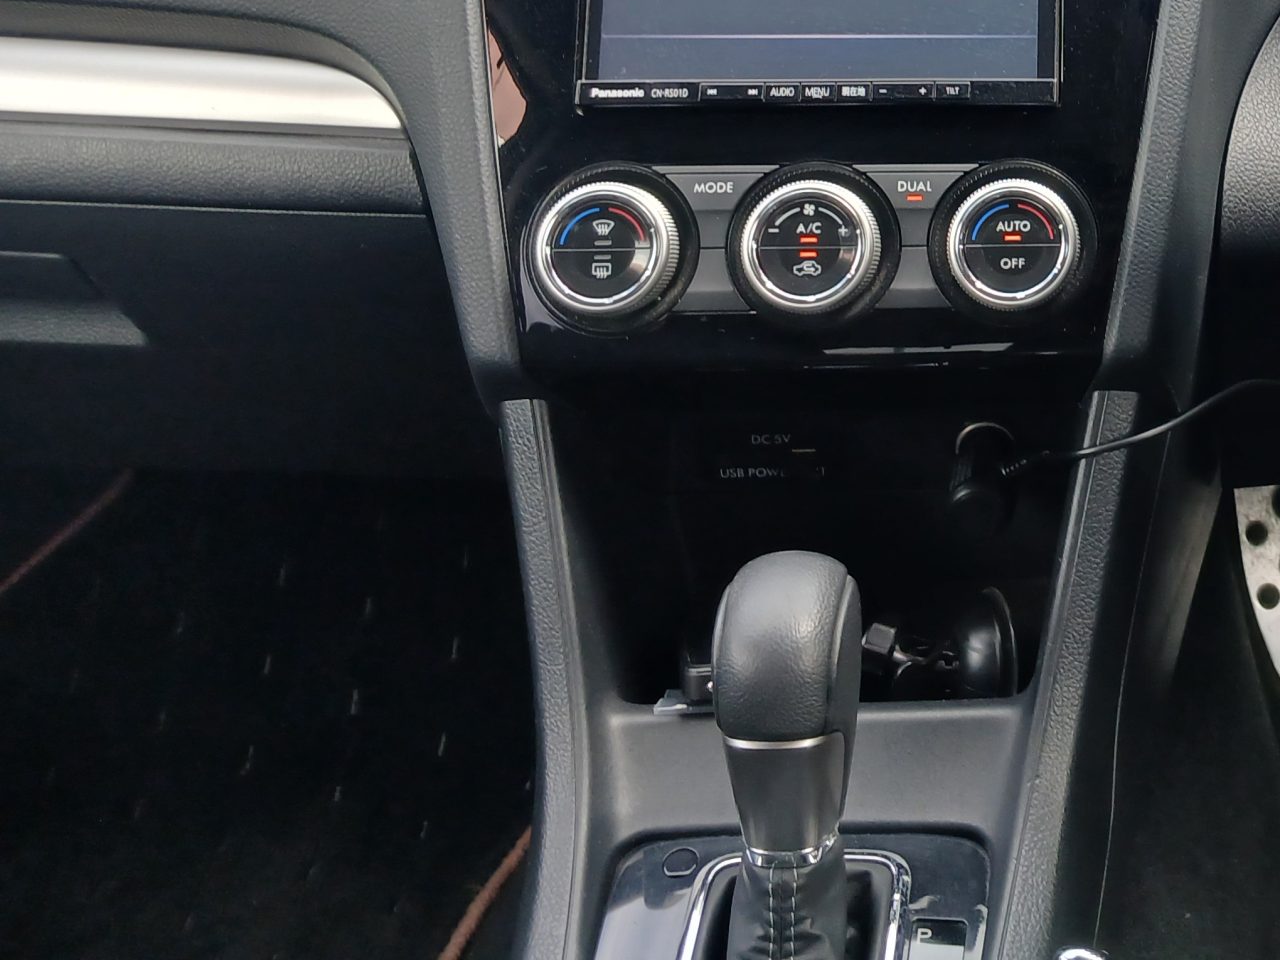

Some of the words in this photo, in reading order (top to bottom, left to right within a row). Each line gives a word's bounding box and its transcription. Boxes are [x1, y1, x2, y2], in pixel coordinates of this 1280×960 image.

[590, 87, 645, 99] Panasonic
[770, 86, 795, 97] AUDIO
[805, 86, 830, 98] MENU
[693, 182, 734, 193] MODE
[897, 181, 932, 192] DUAL
[796, 222, 822, 235] A/C
[996, 220, 1031, 232] AUTO
[1000, 257, 1026, 270] OFF
[751, 434, 770, 445] DC
[775, 434, 792, 445] 5V
[719, 467, 745, 479] USB
[917, 928, 933, 945] P
